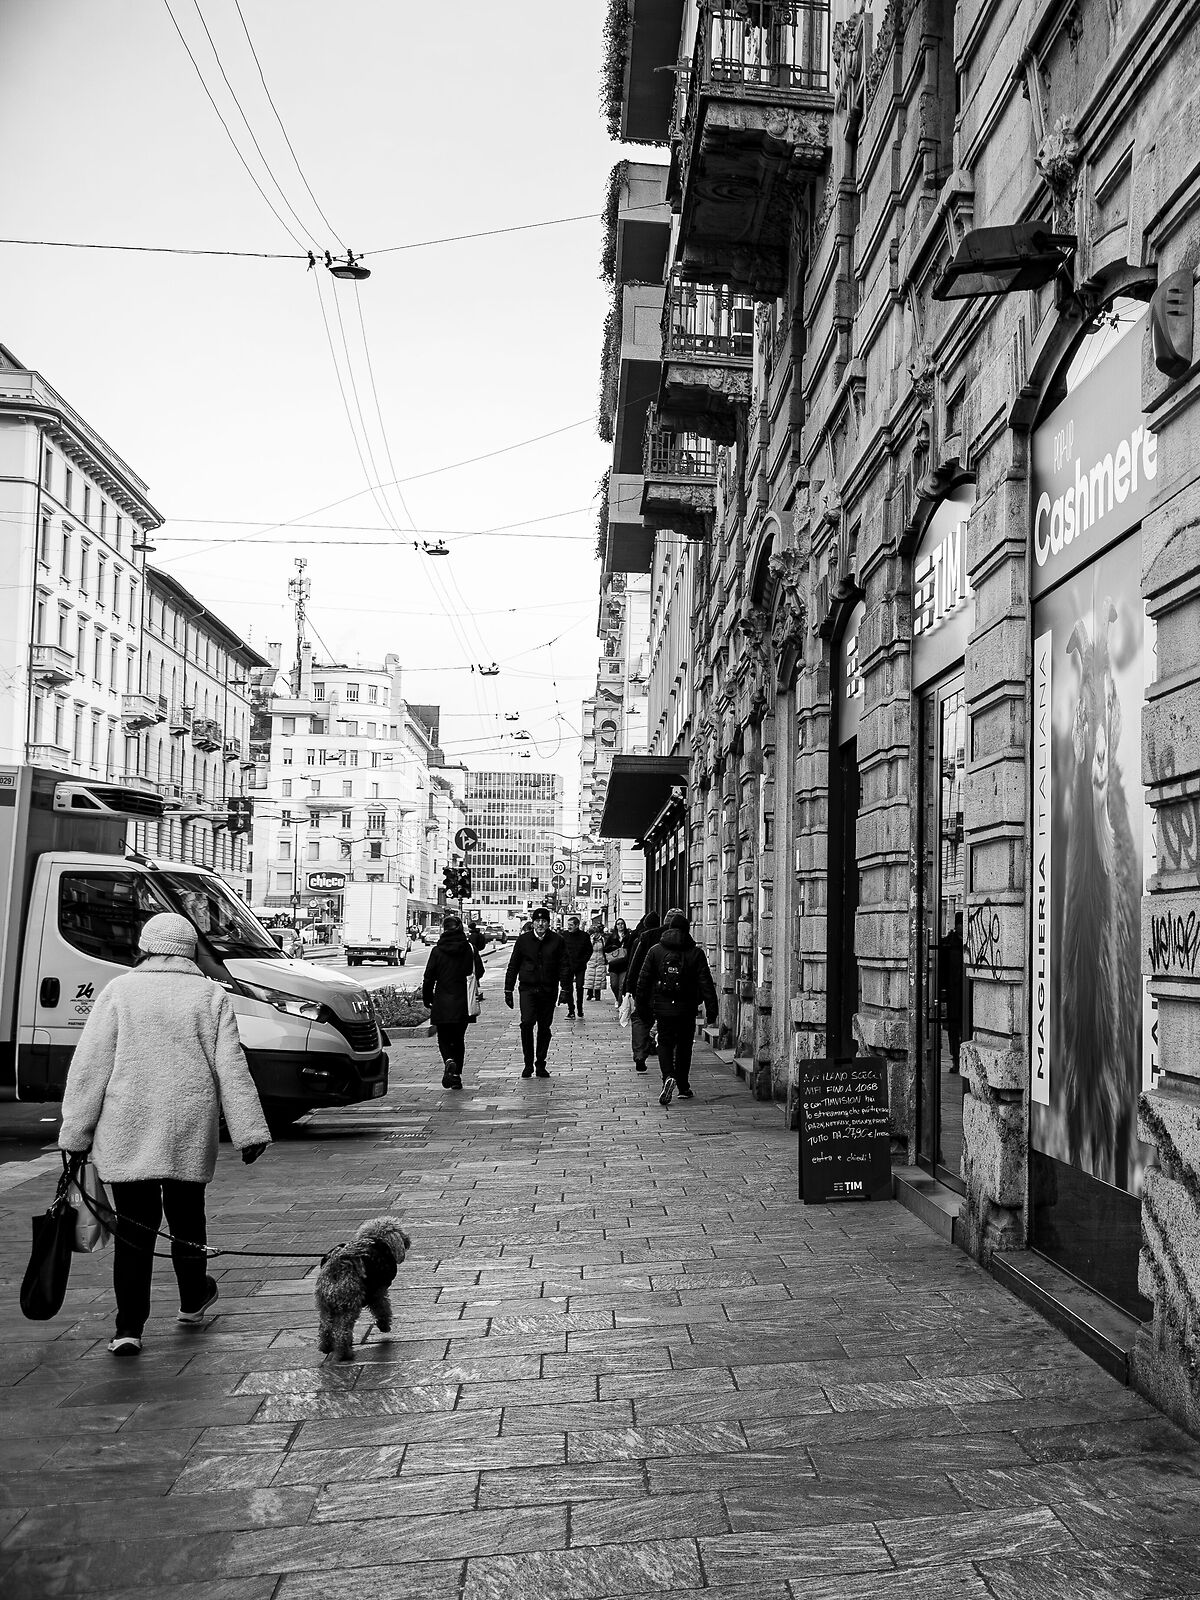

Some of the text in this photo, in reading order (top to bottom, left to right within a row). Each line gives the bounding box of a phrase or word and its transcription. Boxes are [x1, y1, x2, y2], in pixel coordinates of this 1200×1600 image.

[1034, 424, 1158, 567] Cashmere
[933, 520, 967, 620] TIM
[310, 872, 345, 888] chicco
[579, 876, 589, 887] P
[1036, 651, 1048, 1080] MAGLIERIA ITALIANA
[844, 1181, 863, 1191] TIM
